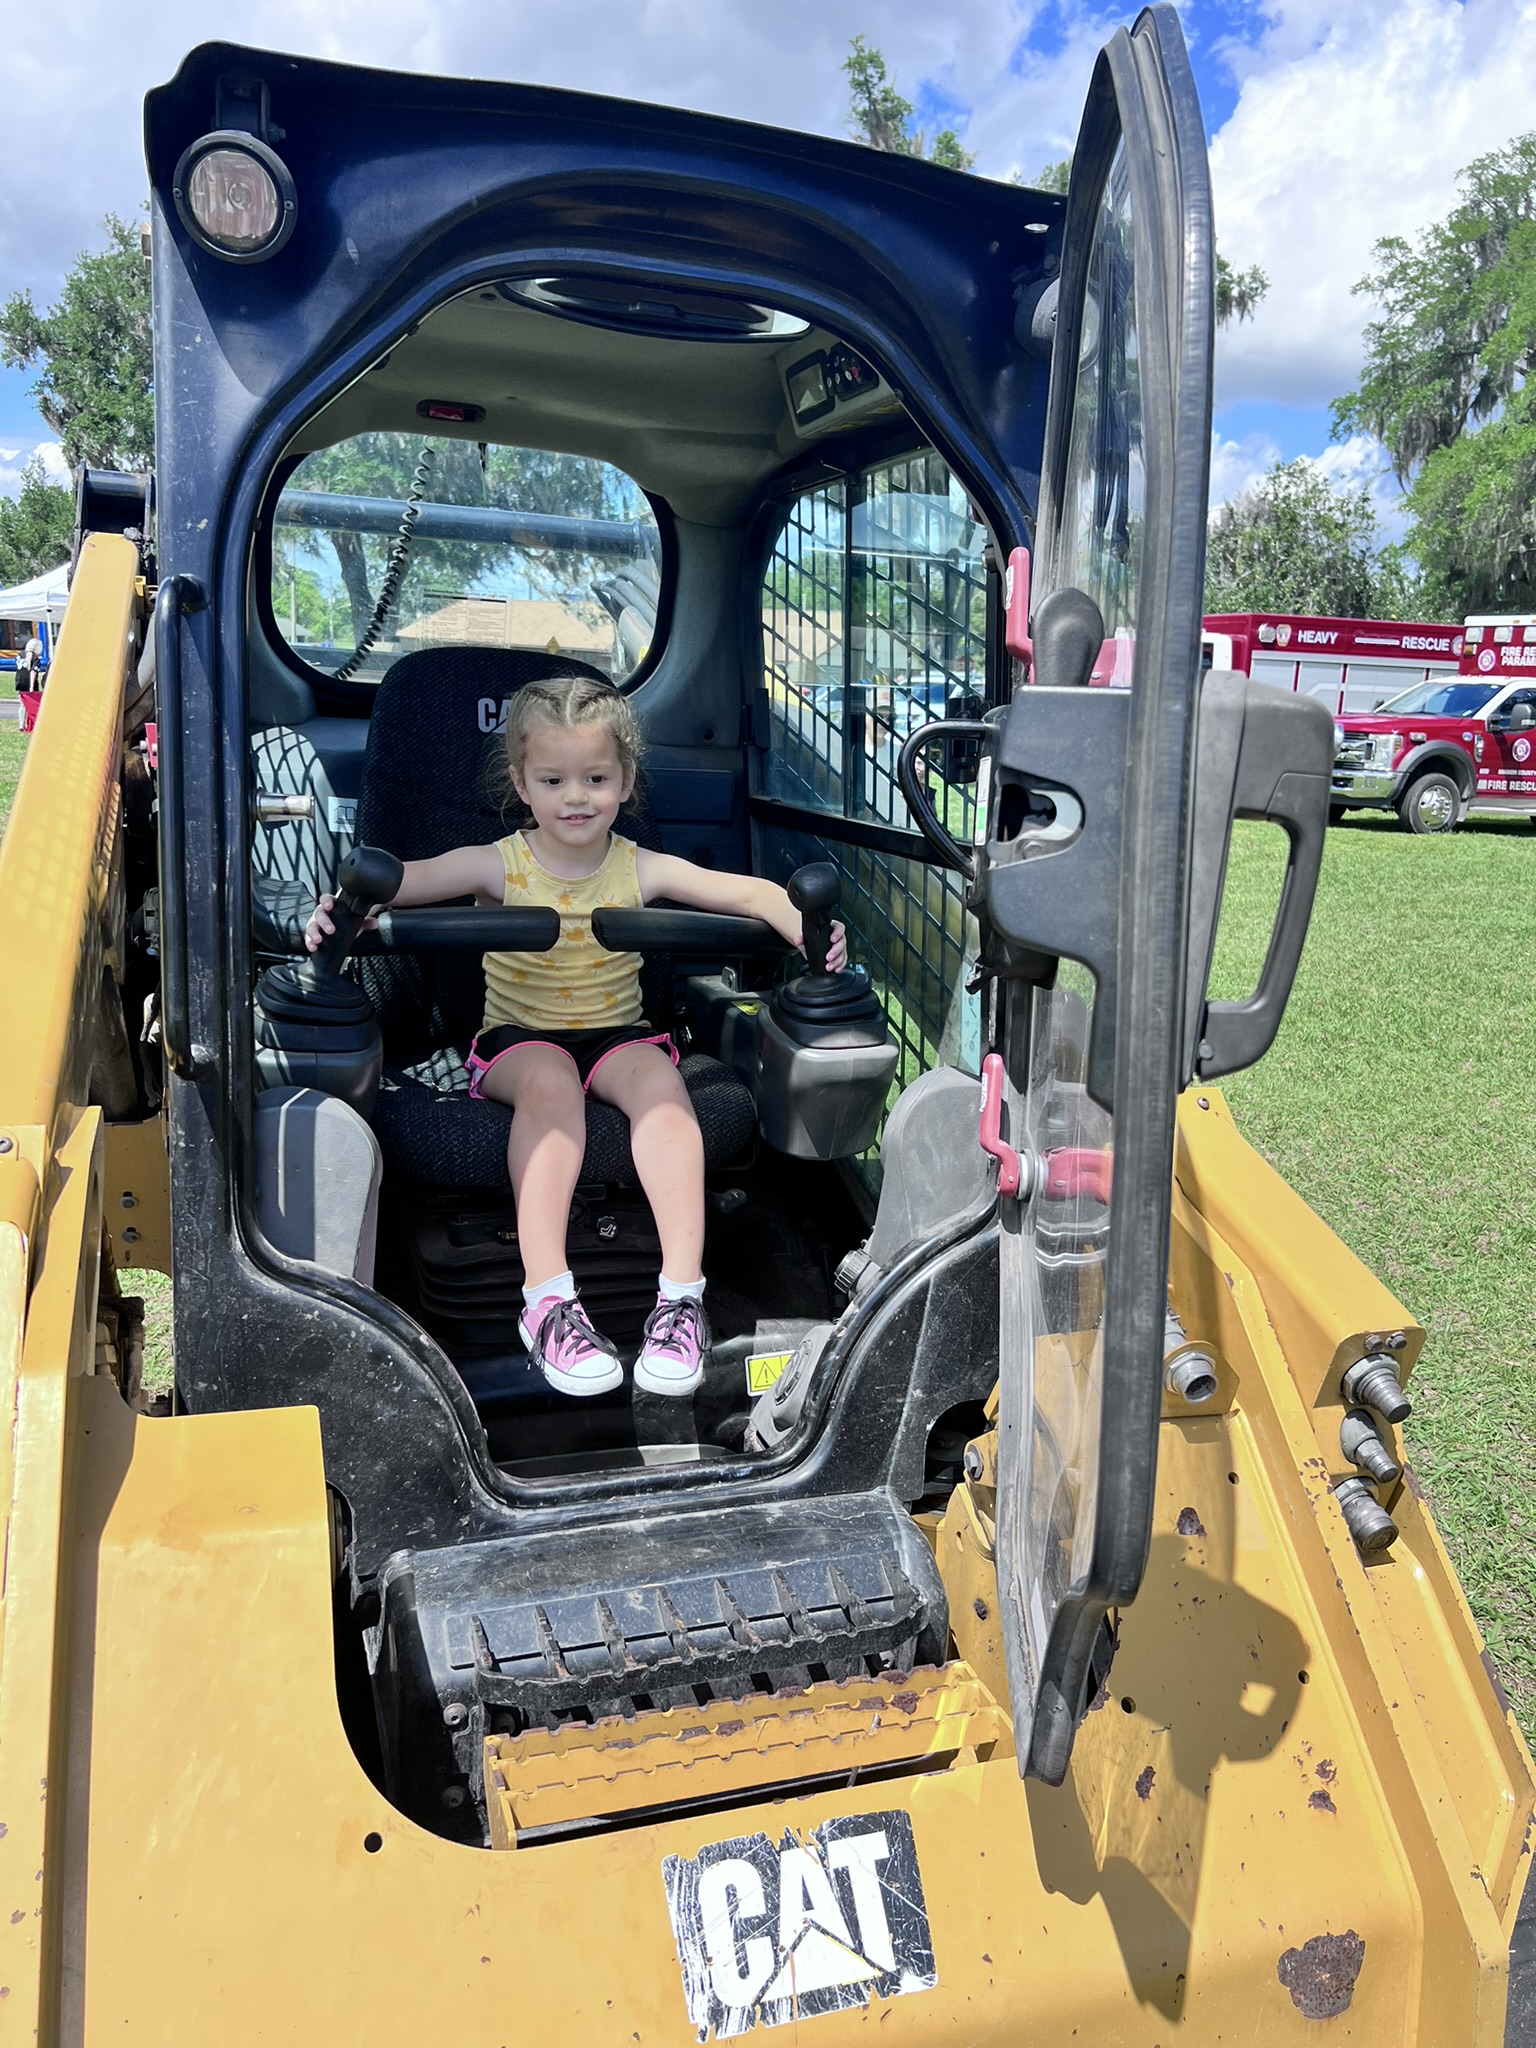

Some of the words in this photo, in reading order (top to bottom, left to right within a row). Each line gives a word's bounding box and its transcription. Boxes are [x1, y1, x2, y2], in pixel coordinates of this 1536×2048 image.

[1297, 630, 1338, 645] HEAVY
[1402, 636, 1450, 651] RESCUE
[1500, 646, 1522, 656] FIRE
[1501, 656, 1536, 666] PARAM
[478, 698, 512, 733] CA
[1487, 780, 1507, 790] FIRE
[699, 1830, 897, 2007] CAT
